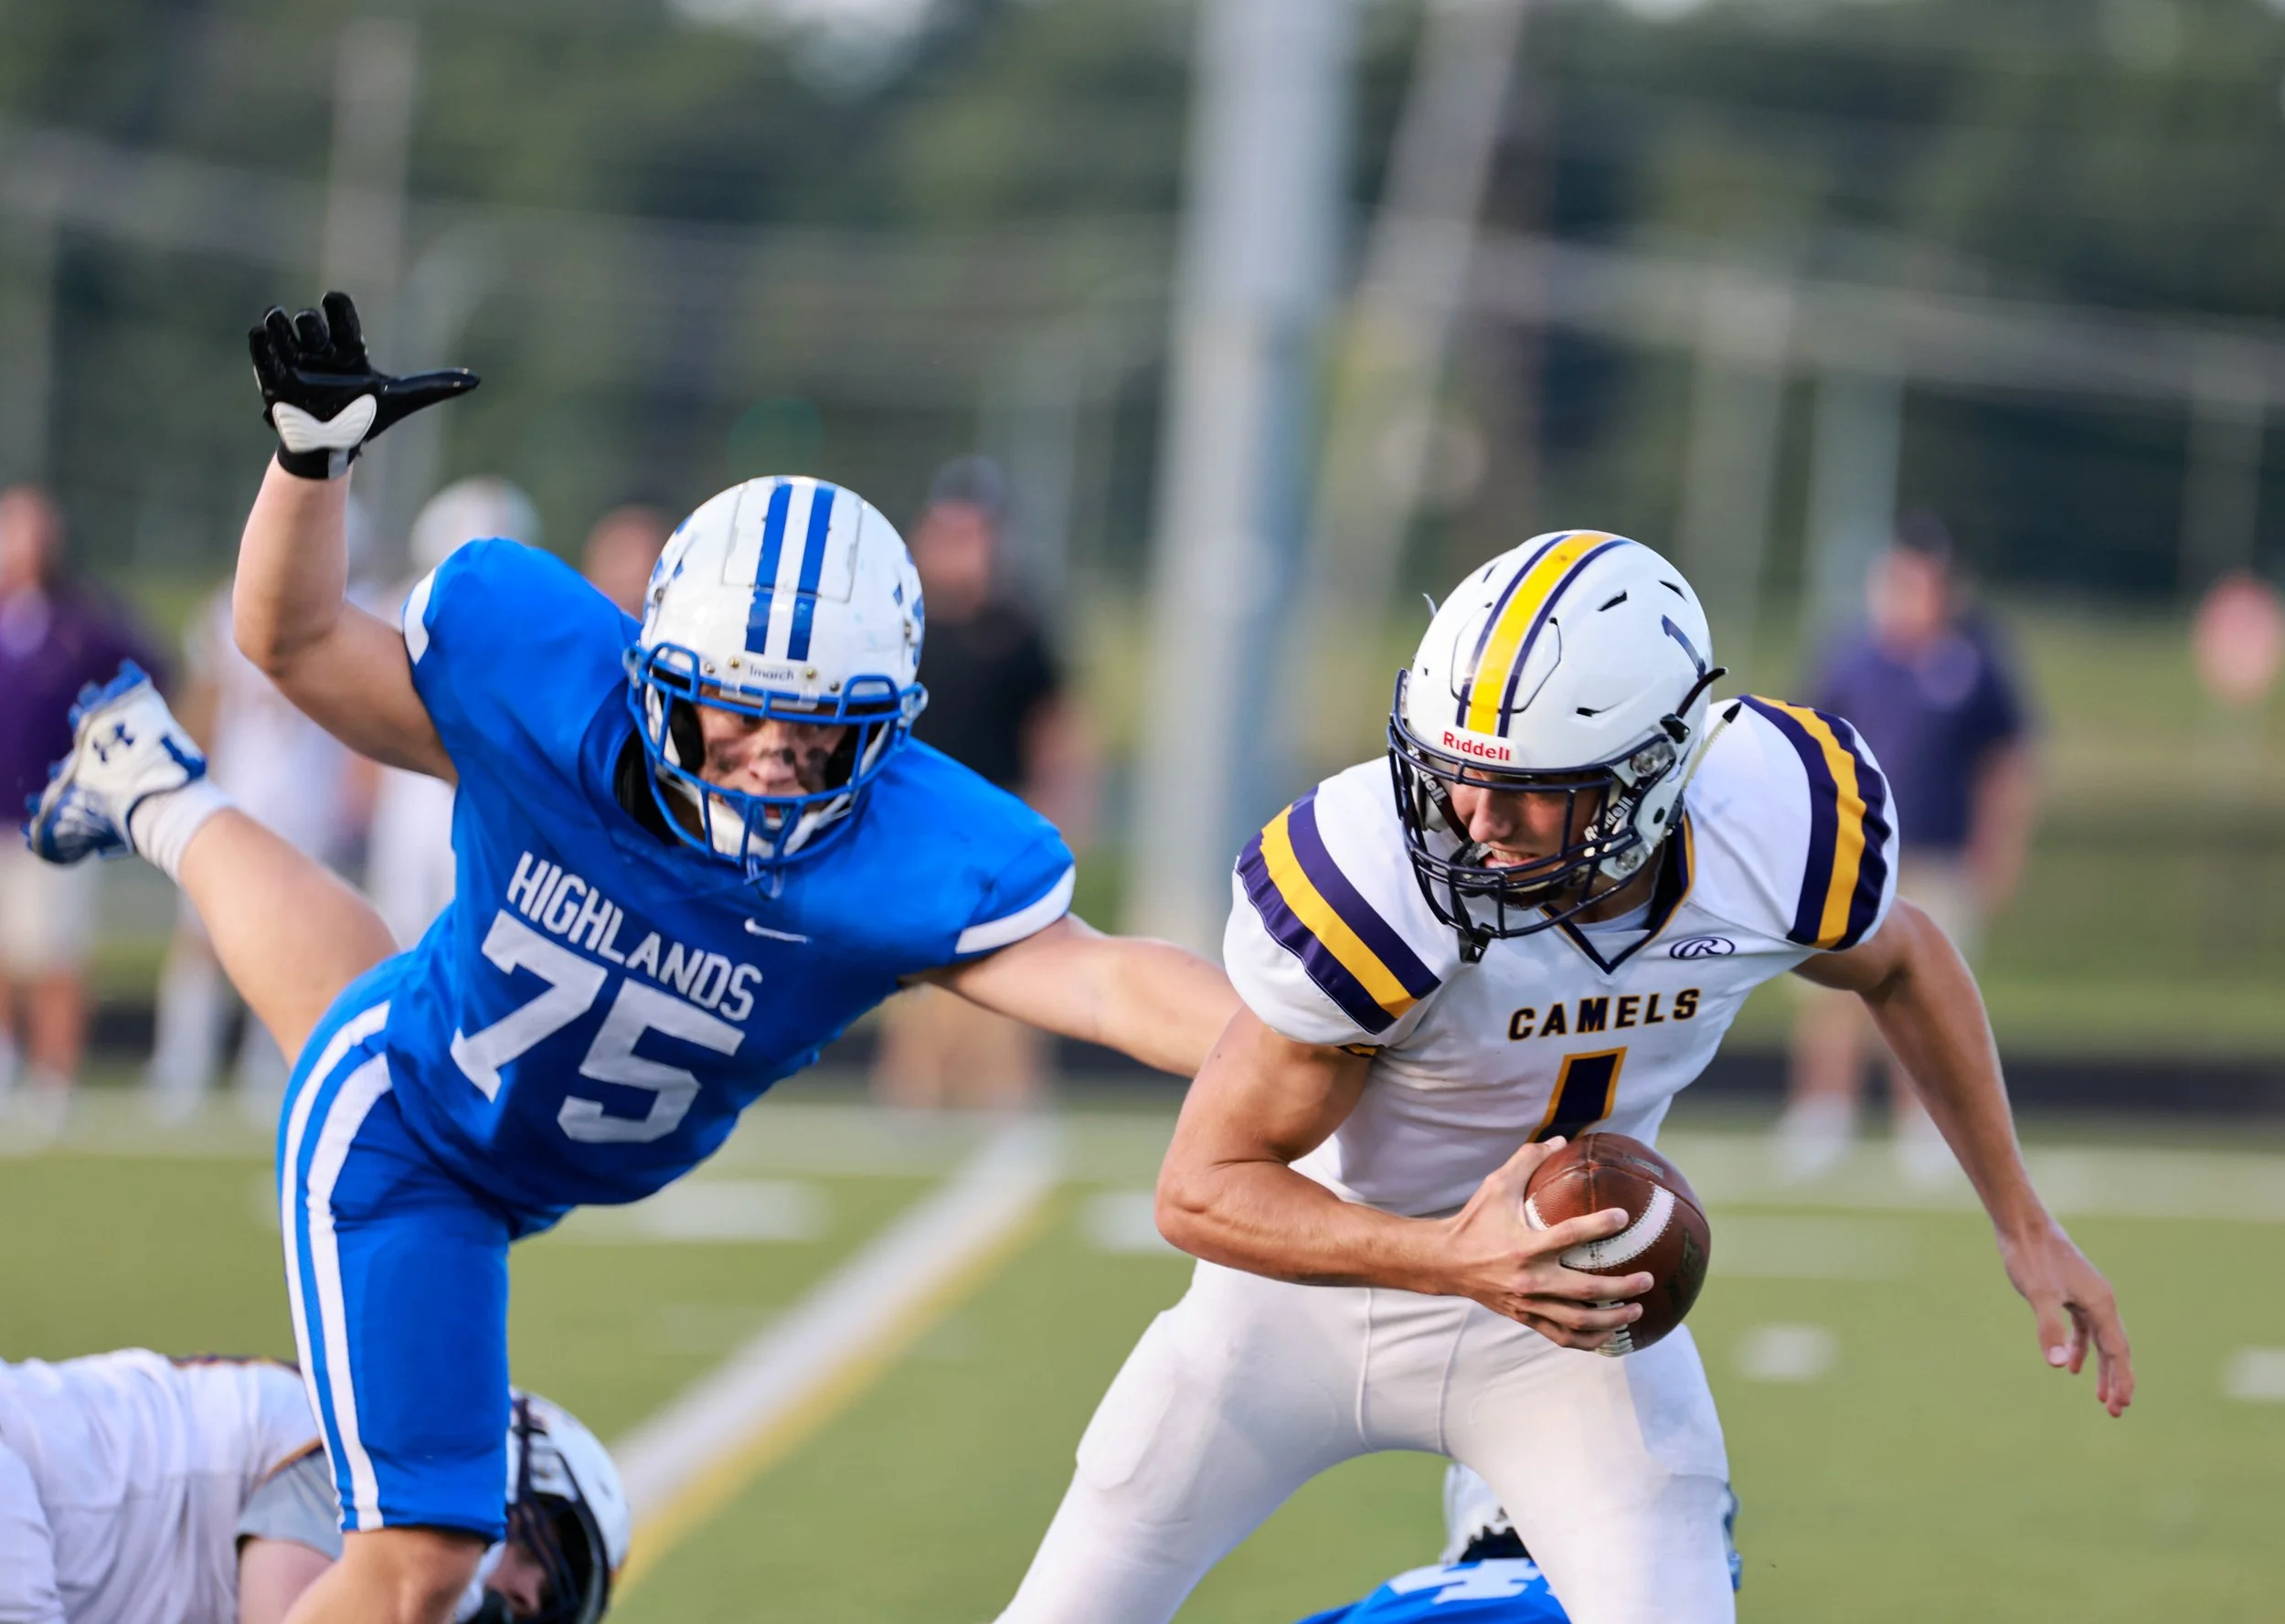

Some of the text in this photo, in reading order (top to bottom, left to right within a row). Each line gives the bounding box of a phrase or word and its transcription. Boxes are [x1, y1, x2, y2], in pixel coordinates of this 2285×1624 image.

[1443, 730, 1511, 761] Riddell
[506, 851, 763, 1022] HIGHLANDS
[450, 908, 746, 1143] 75
[1508, 988, 1701, 1041] CAMELS
